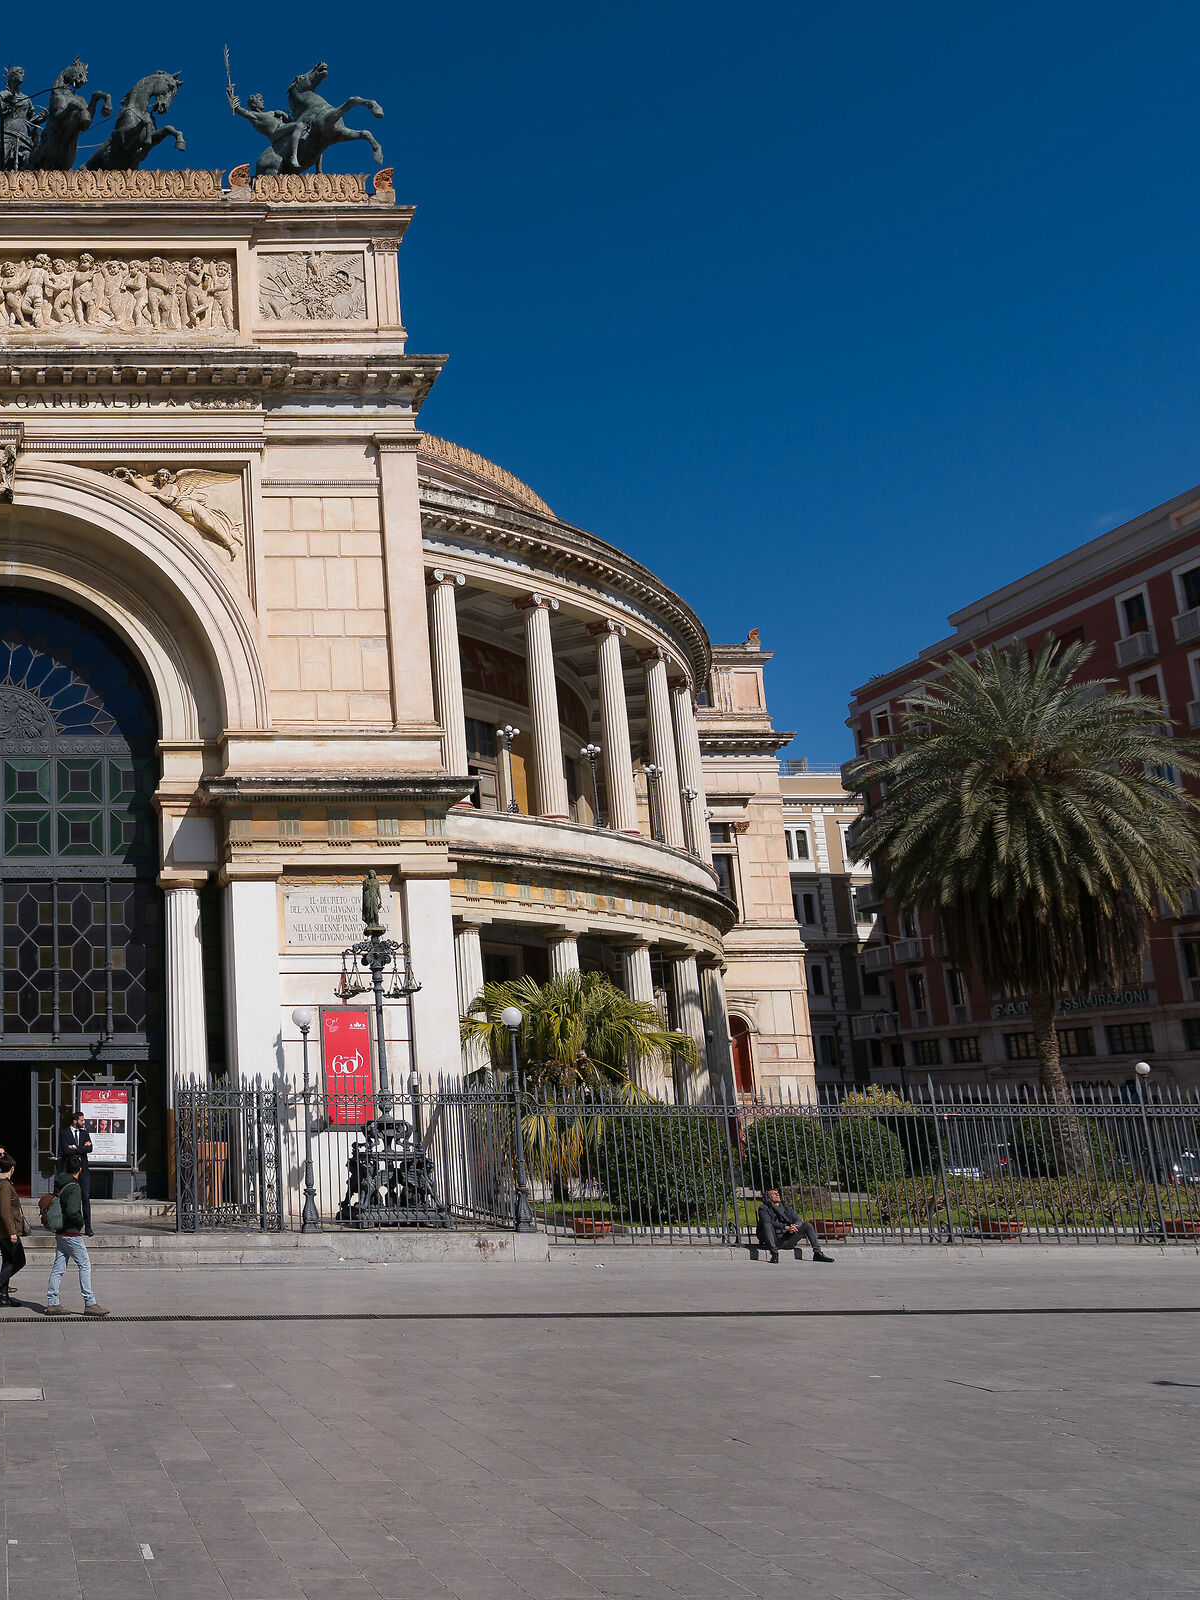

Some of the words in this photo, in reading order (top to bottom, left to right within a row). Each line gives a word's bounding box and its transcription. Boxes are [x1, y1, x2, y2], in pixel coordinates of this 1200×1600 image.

[14, 393, 152, 409] GARIBALDI
[320, 896, 348, 905] DECRETO
[290, 905, 301, 914] DEL
[292, 923, 312, 932] NELLA
[315, 923, 341, 932] SOLENNE
